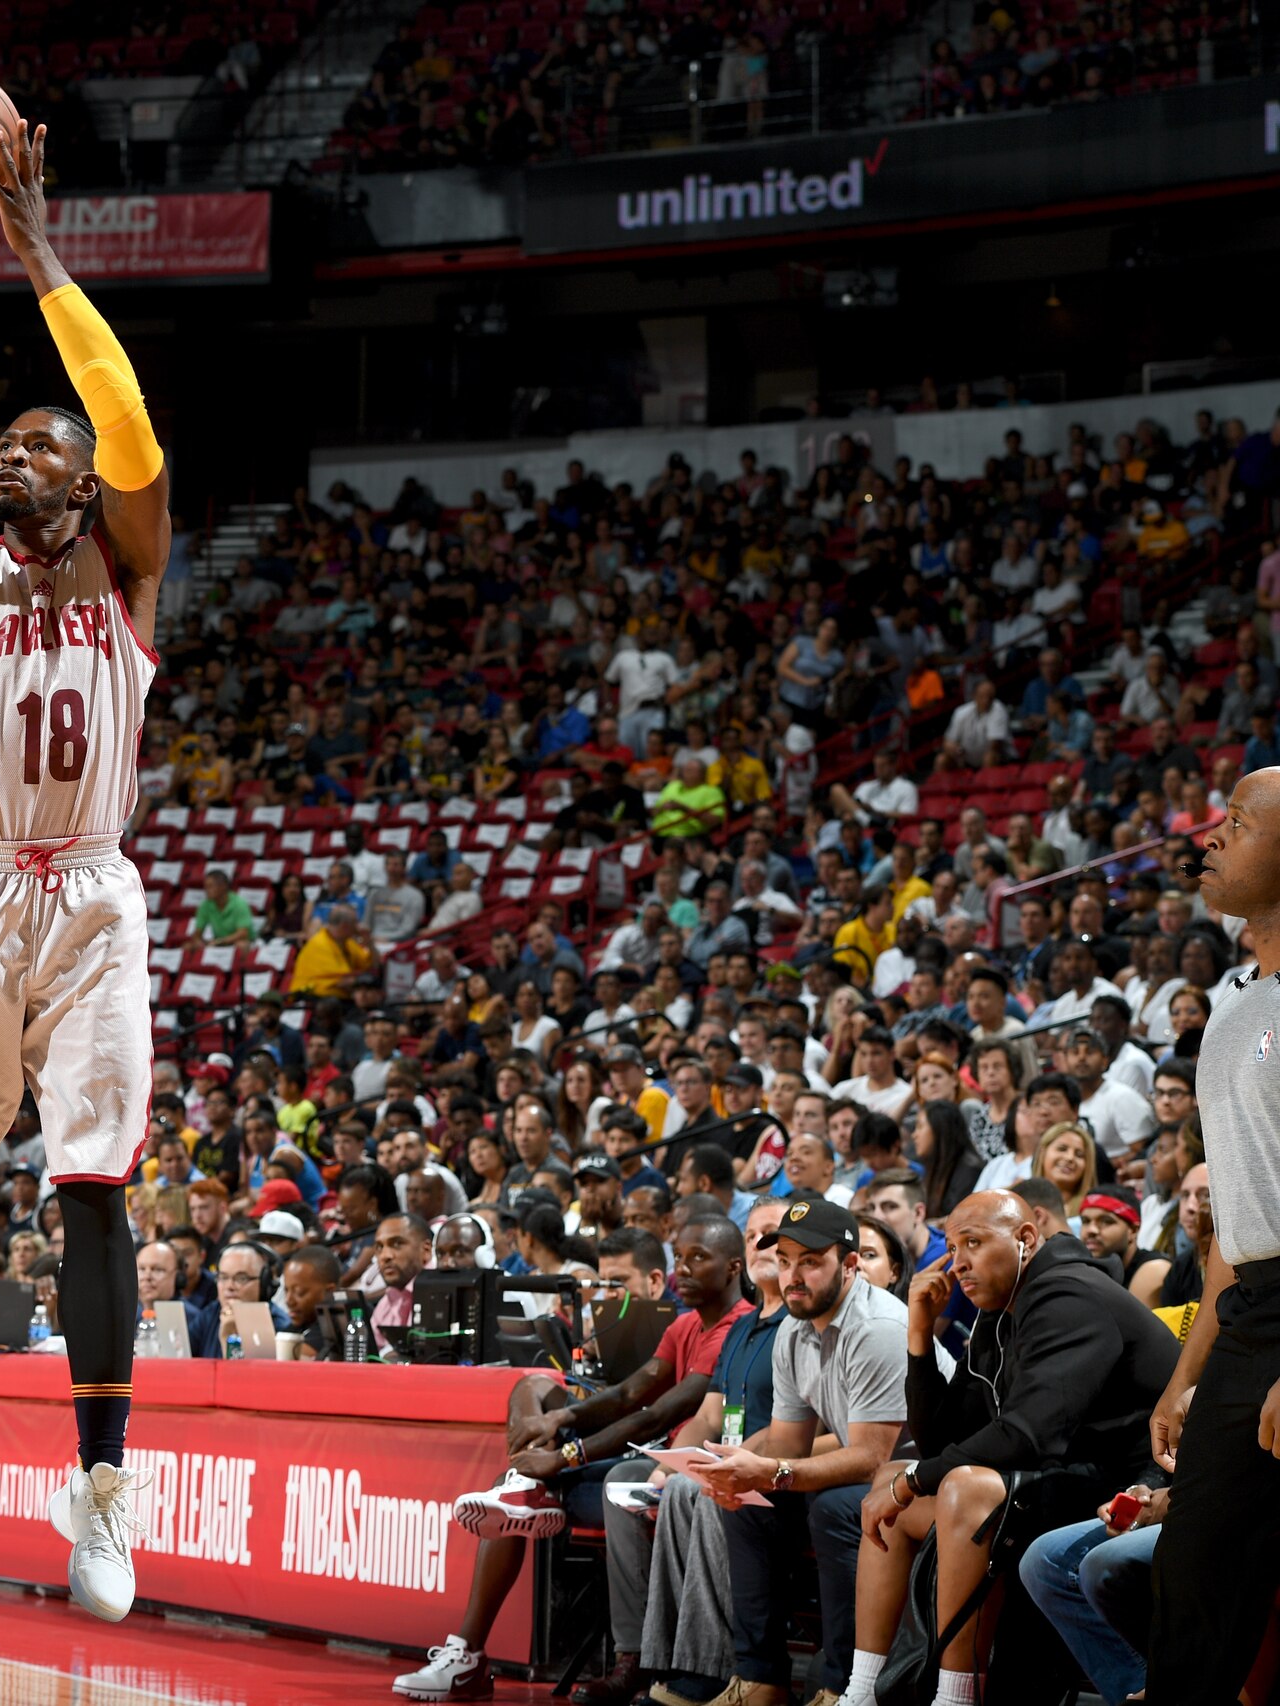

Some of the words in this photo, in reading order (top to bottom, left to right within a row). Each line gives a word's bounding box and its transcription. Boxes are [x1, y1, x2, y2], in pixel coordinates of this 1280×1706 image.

[617, 157, 864, 230] unlimited
[17, 689, 88, 784] 18
[178, 1452, 256, 1567] LEAGUE
[281, 1464, 453, 1594] #NBASummer
